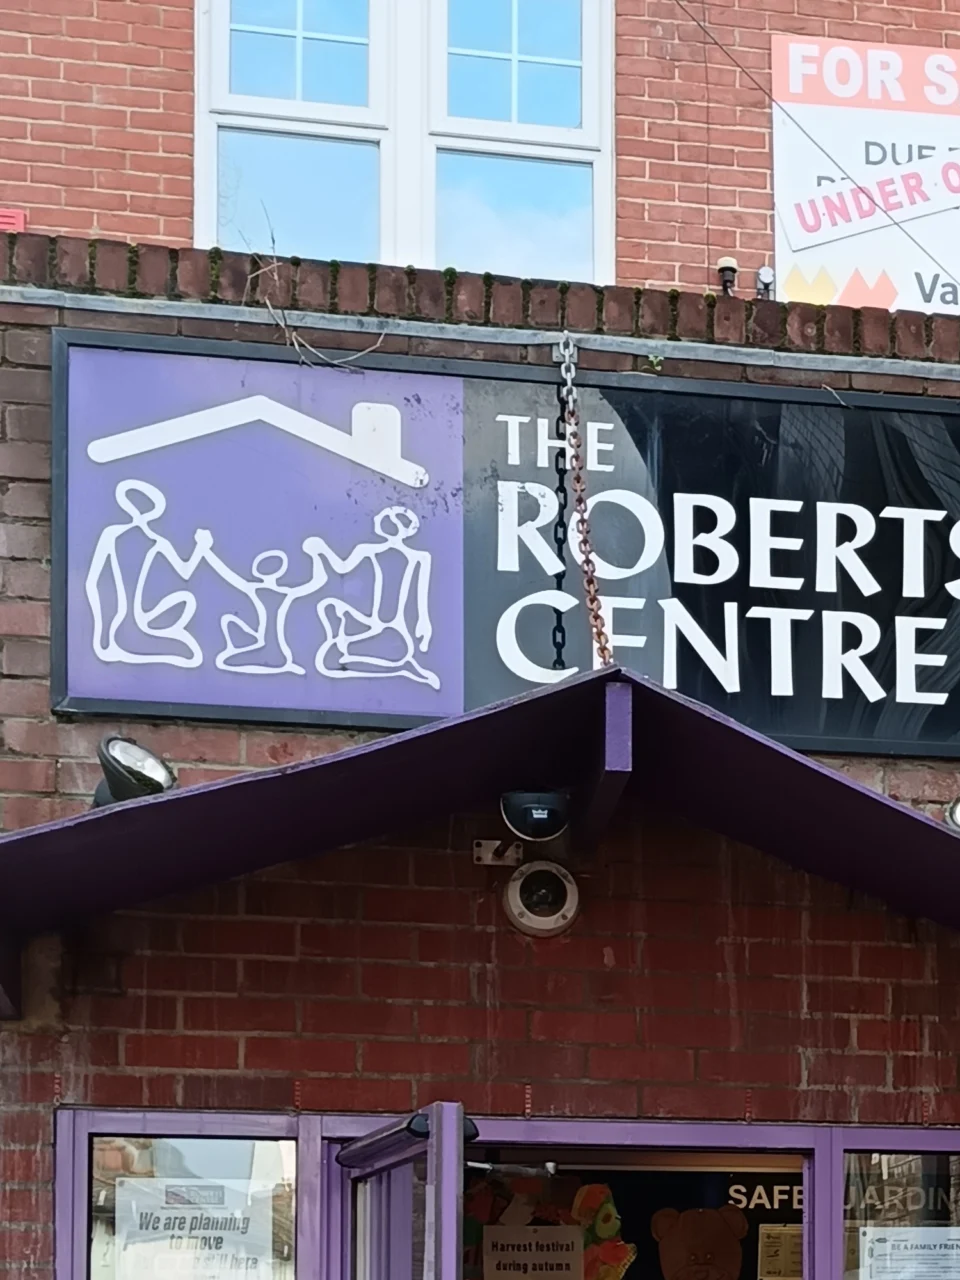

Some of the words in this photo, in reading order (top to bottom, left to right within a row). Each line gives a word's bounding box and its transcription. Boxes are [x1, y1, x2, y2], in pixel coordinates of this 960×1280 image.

[787, 43, 905, 101] FOR
[794, 171, 930, 233] UNDER
[495, 413, 615, 473] THE
[495, 590, 949, 705] CENTRE
[139, 1212, 161, 1231] We
[163, 1217, 187, 1231] are
[189, 1212, 250, 1235] planning
[491, 1241, 532, 1252] Harvest
[535, 1241, 574, 1252] festival
[909, 1243, 938, 1251] FAMILY
[496, 1260, 528, 1274] during
[532, 1262, 571, 1271] autumn
